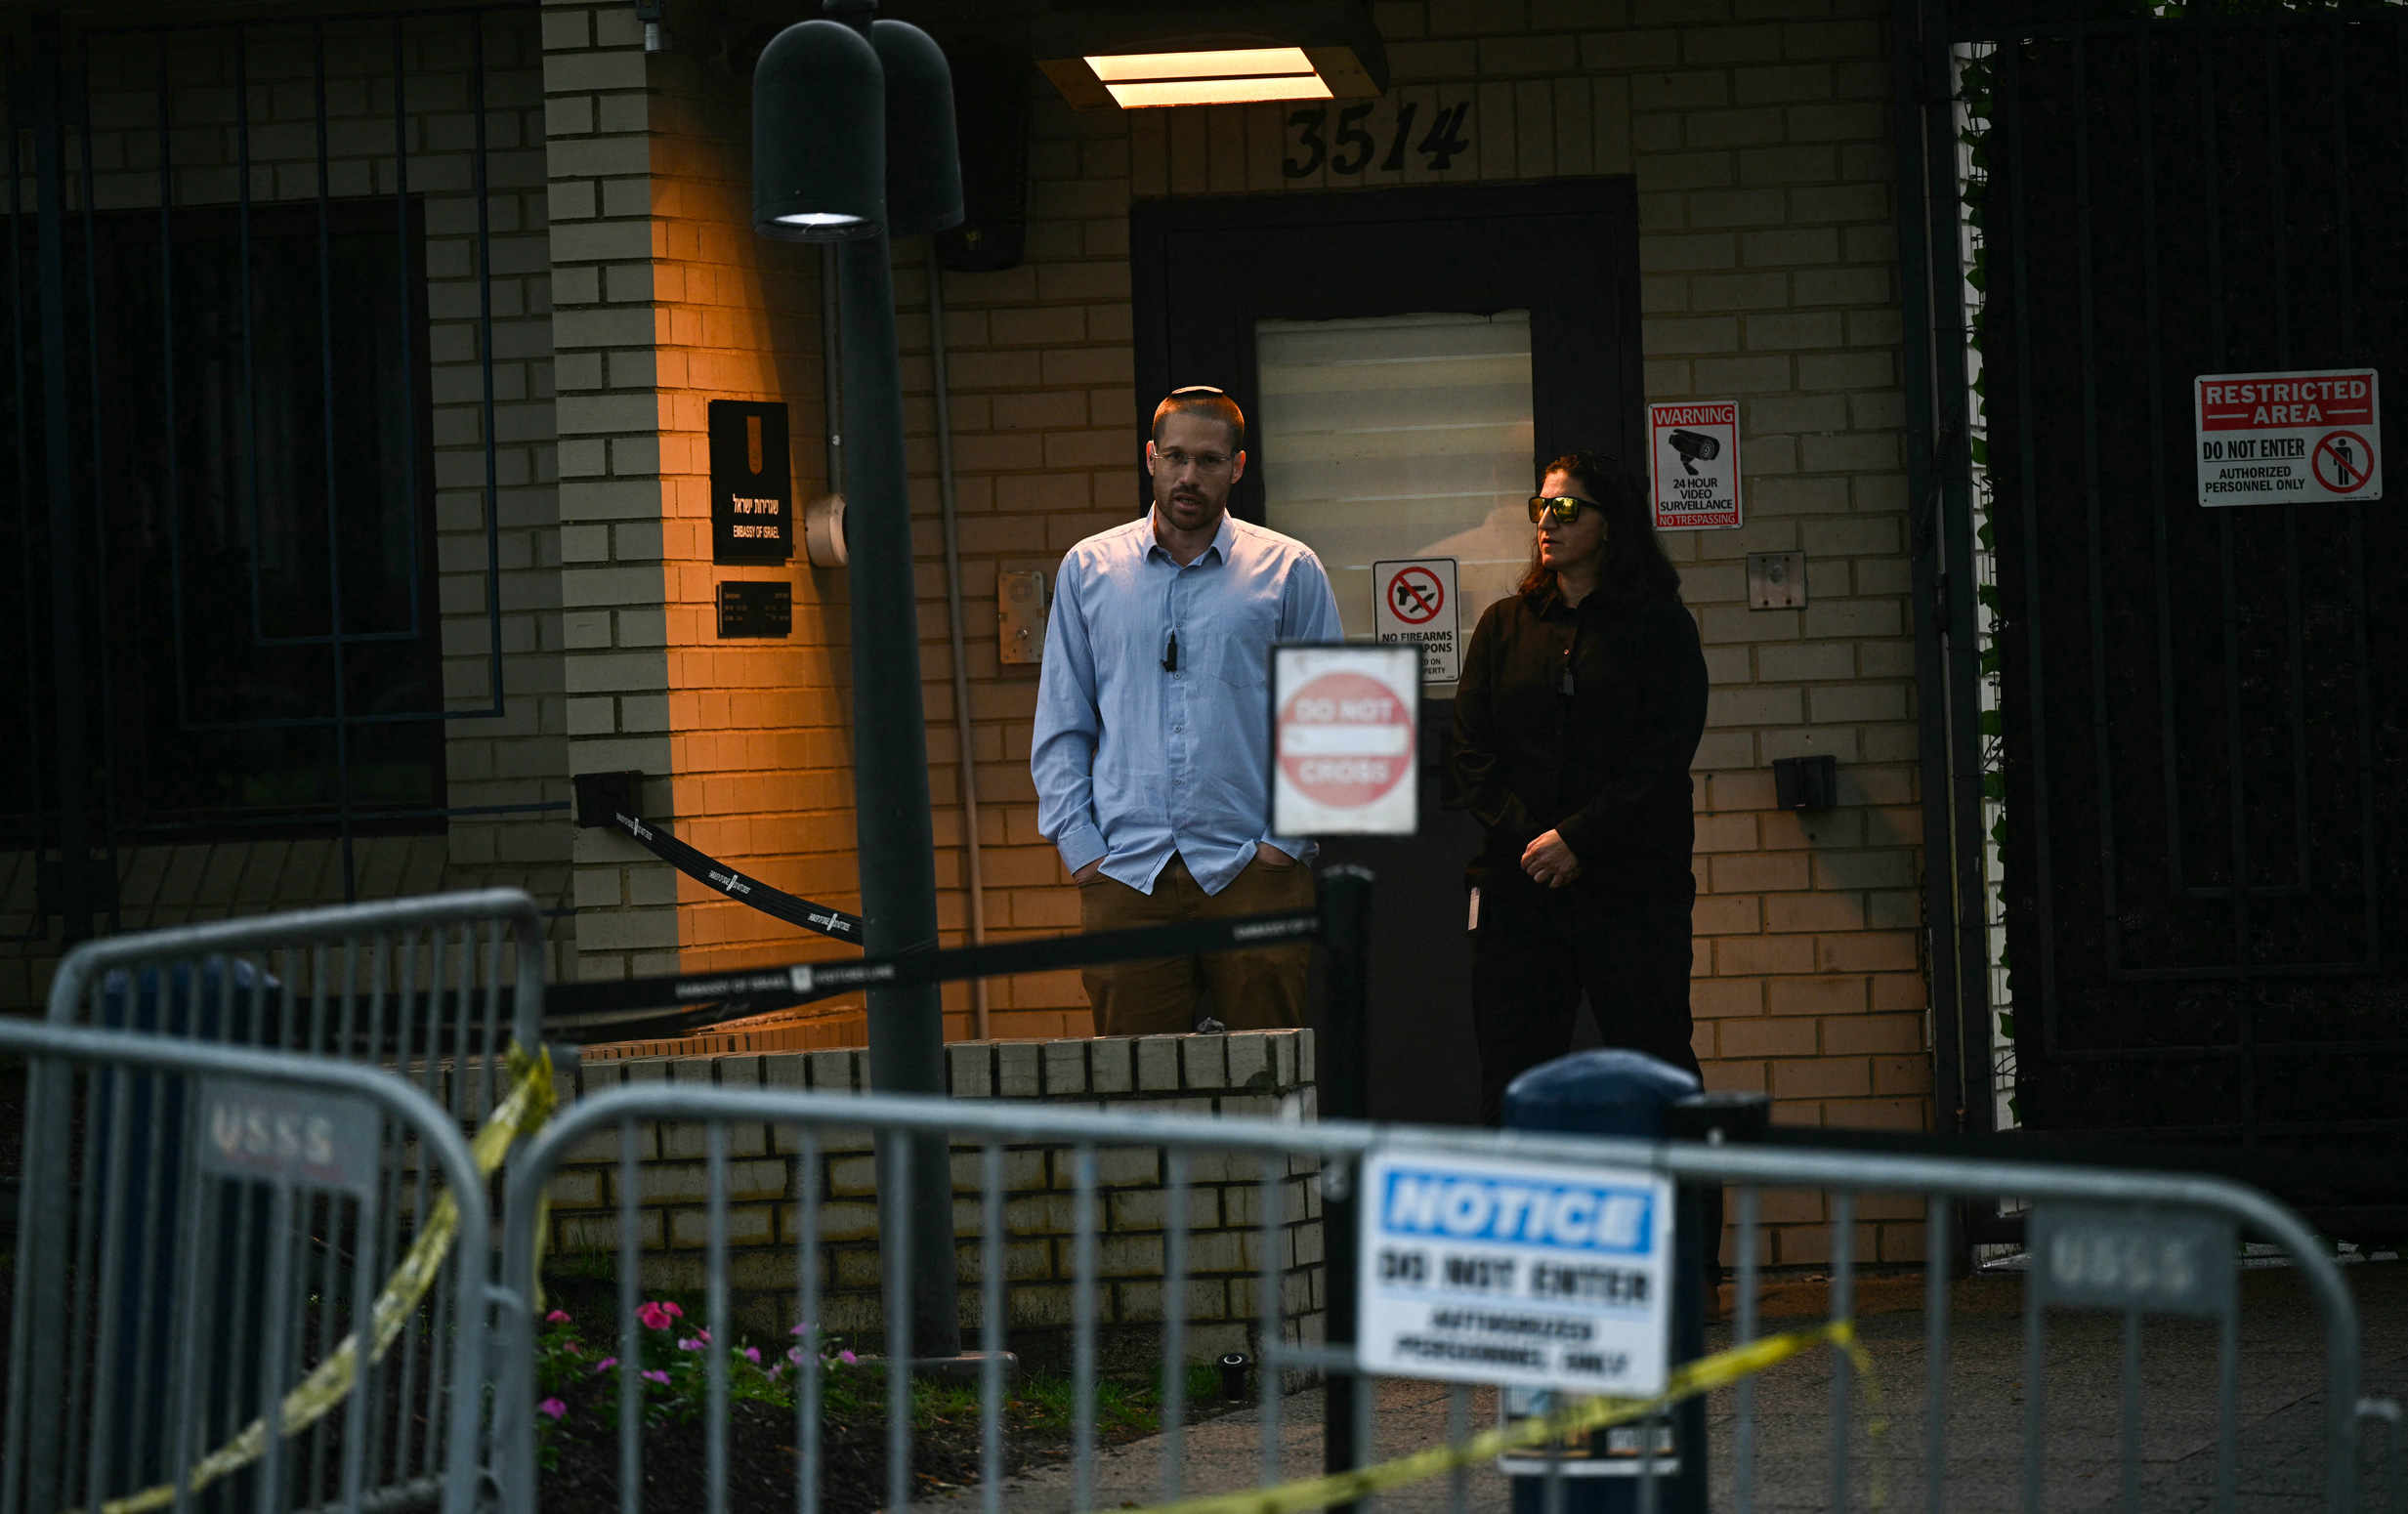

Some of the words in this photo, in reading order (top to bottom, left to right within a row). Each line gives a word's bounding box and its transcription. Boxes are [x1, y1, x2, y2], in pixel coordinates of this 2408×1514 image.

[1283, 101, 1469, 179] 3514
[2206, 380, 2367, 405] RESTRICTED
[1654, 406, 1734, 425] WARNING
[2253, 403, 2323, 425] AREA
[2203, 442, 2222, 460] DO
[2228, 440, 2256, 459] NOT
[2260, 438, 2305, 457] ENTER
[2219, 466, 2291, 480] AUTHORIZED
[1673, 479, 1686, 488] 24
[1688, 478, 1717, 488] HOUR
[2205, 480, 2273, 493] PERSONNEL
[2276, 479, 2305, 490] ONLY
[733, 493, 753, 514] ישראל
[1680, 489, 1712, 499] VIDEO
[1660, 499, 1733, 511] SURVEILLANCE
[1660, 516, 1674, 526] NO
[1675, 514, 1736, 526] TRESPASSING
[733, 525, 756, 538] EMBASSY
[756, 526, 763, 538] OF
[763, 526, 781, 539] ISRAEL
[1382, 633, 1398, 643] NO
[1401, 631, 1453, 642] FIREARMS
[1339, 697, 1393, 724] NOT
[1388, 1176, 1646, 1250] NOTICE
[1378, 1247, 1427, 1283] DO
[1446, 1253, 1515, 1290] NOT
[1530, 1260, 1650, 1302] ENTER
